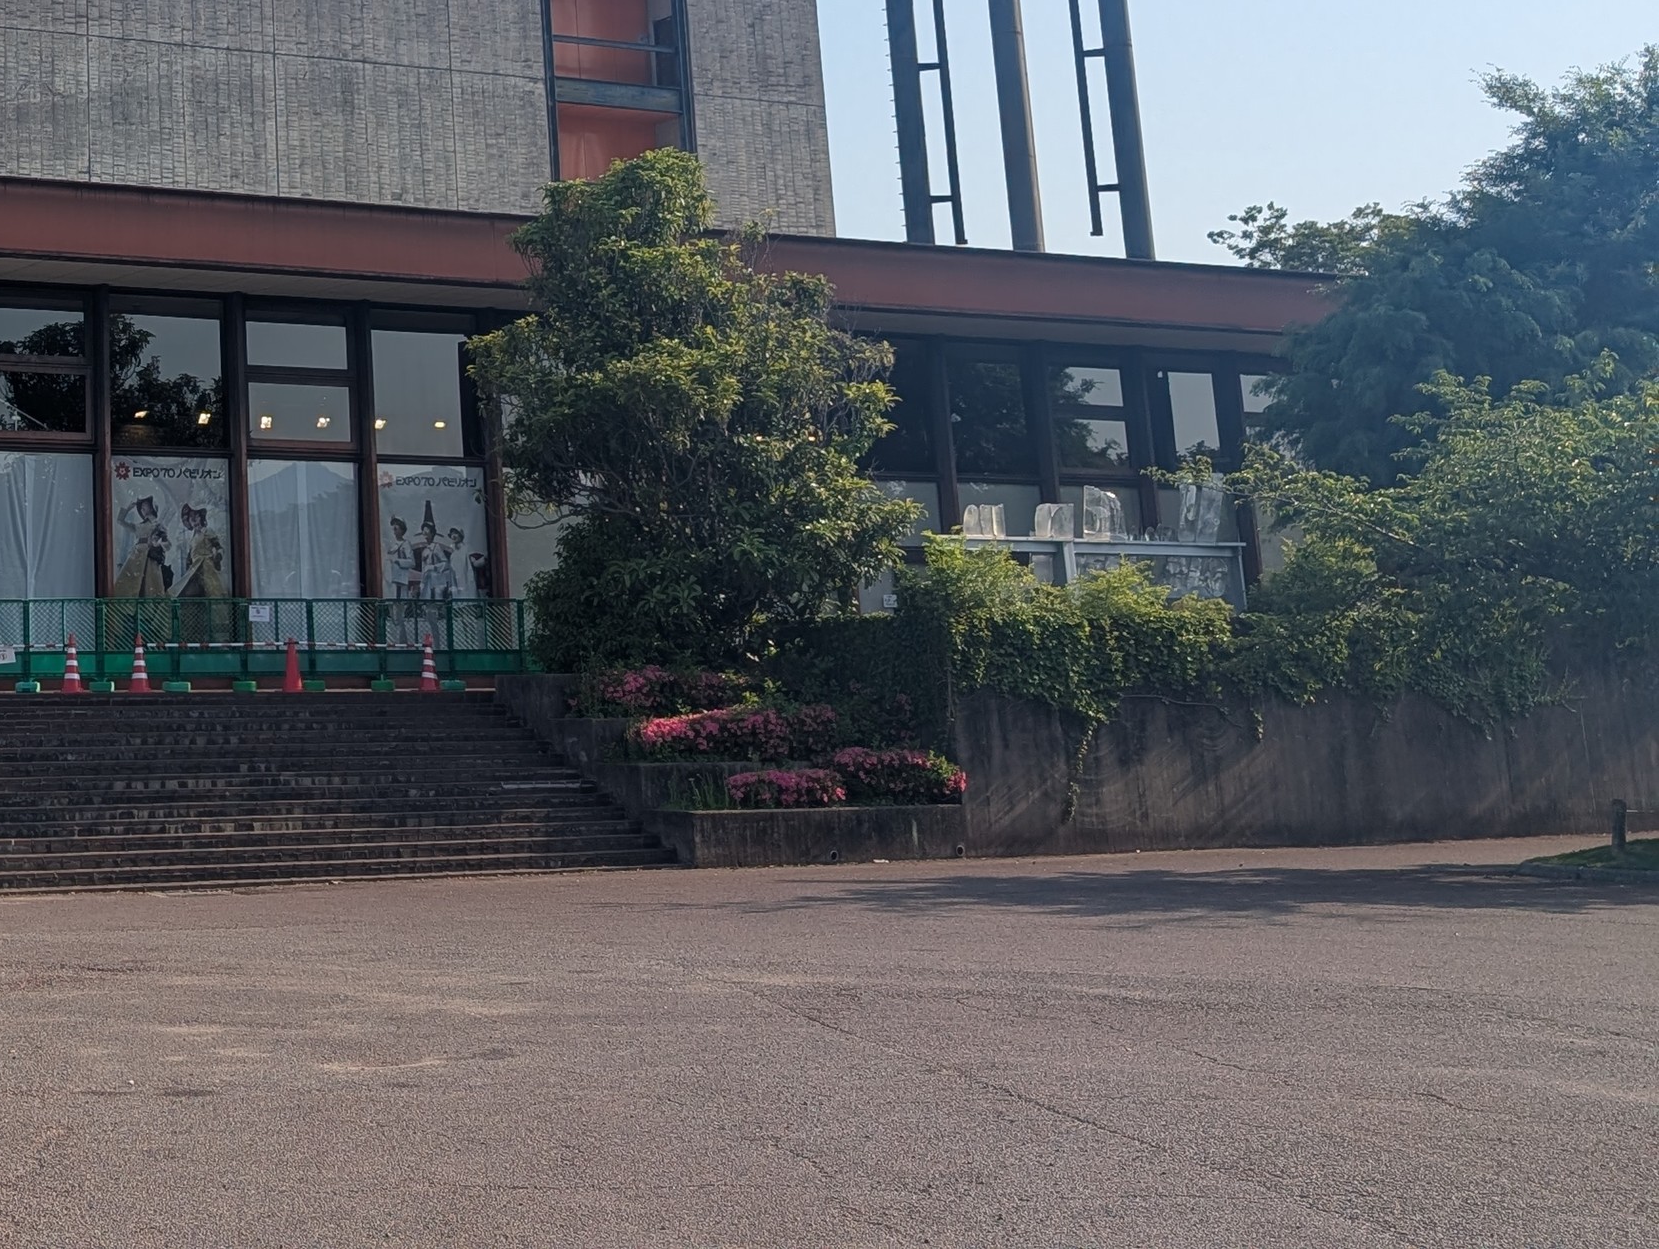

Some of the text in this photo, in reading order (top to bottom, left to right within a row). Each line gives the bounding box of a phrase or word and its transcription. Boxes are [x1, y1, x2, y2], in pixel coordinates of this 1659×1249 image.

[177, 468, 221, 479] パビリオン
[436, 477, 476, 487] パビリオン
